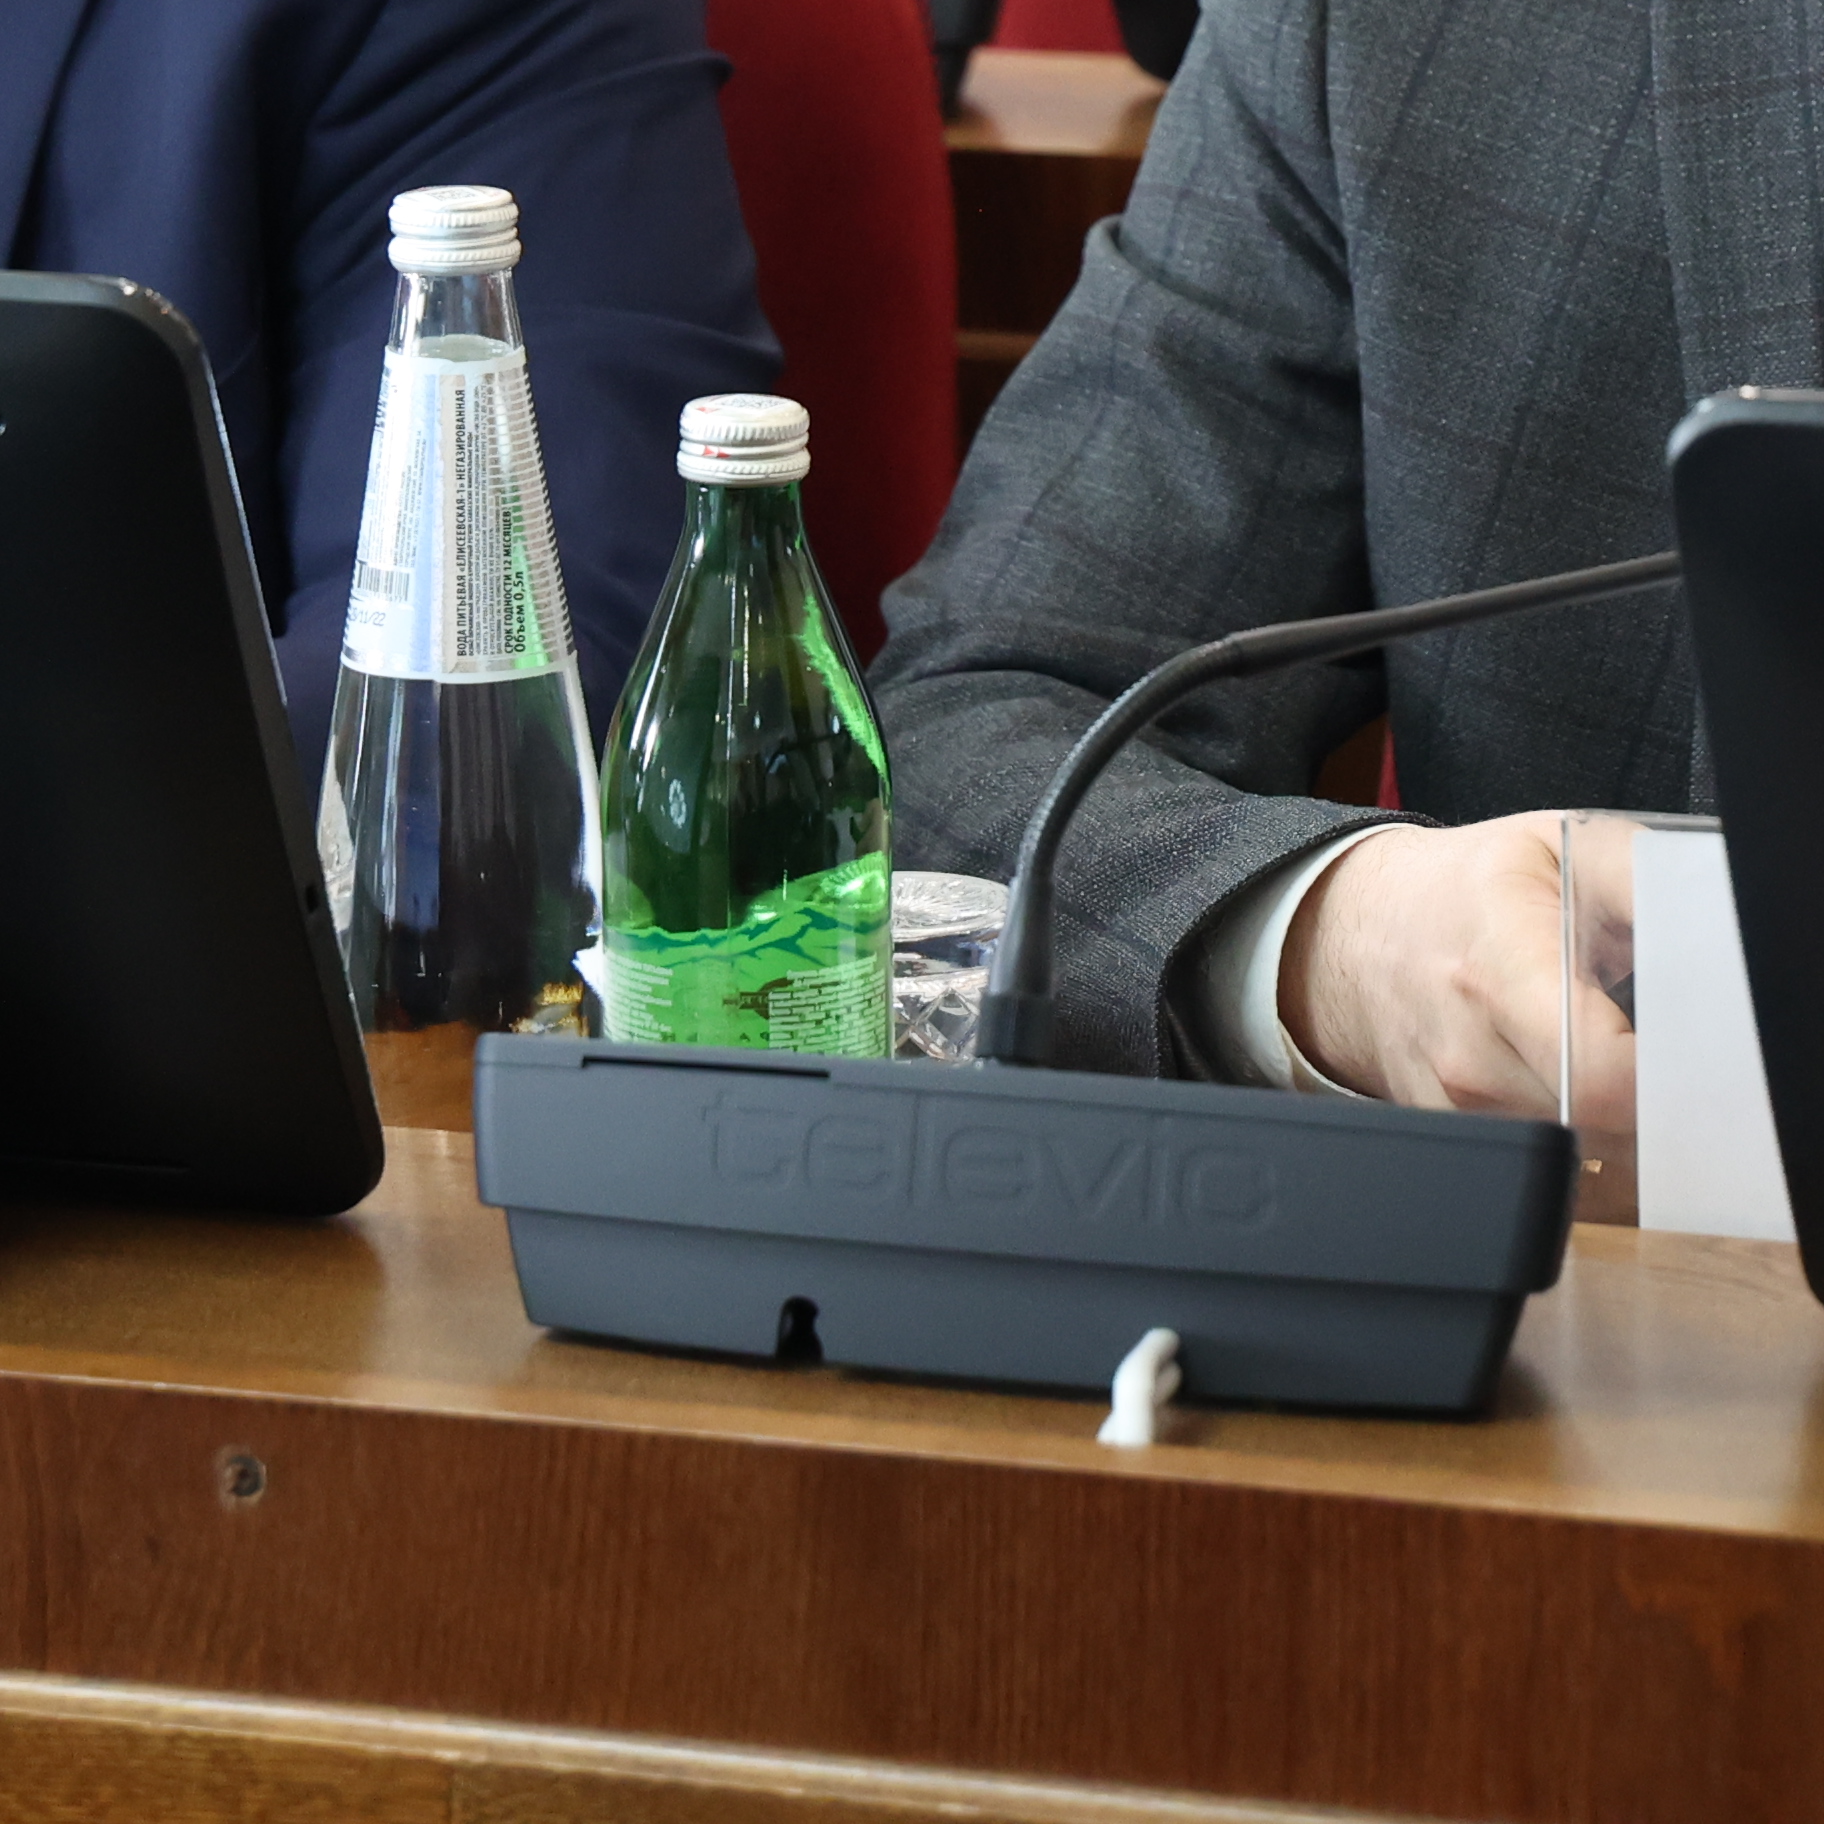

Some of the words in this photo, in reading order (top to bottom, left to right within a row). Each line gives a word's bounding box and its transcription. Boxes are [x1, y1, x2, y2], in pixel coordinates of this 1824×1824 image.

[455, 390, 465, 480] НЕГАЗИРОВАННАЯ
[456, 483, 466, 572] «ЕЛИСЕЕВСКАЯ-1»
[503, 560, 512, 571] 12
[513, 571, 525, 601] 0,5л
[457, 575, 466, 626] ПИТЬЕВАЯ
[503, 574, 513, 626] ГОДНОСТИ
[457, 630, 466, 656] ВОДА
[504, 628, 513, 654] СРОК
[513, 605, 525, 652] Объем
[701, 1088, 1276, 1228] televic
